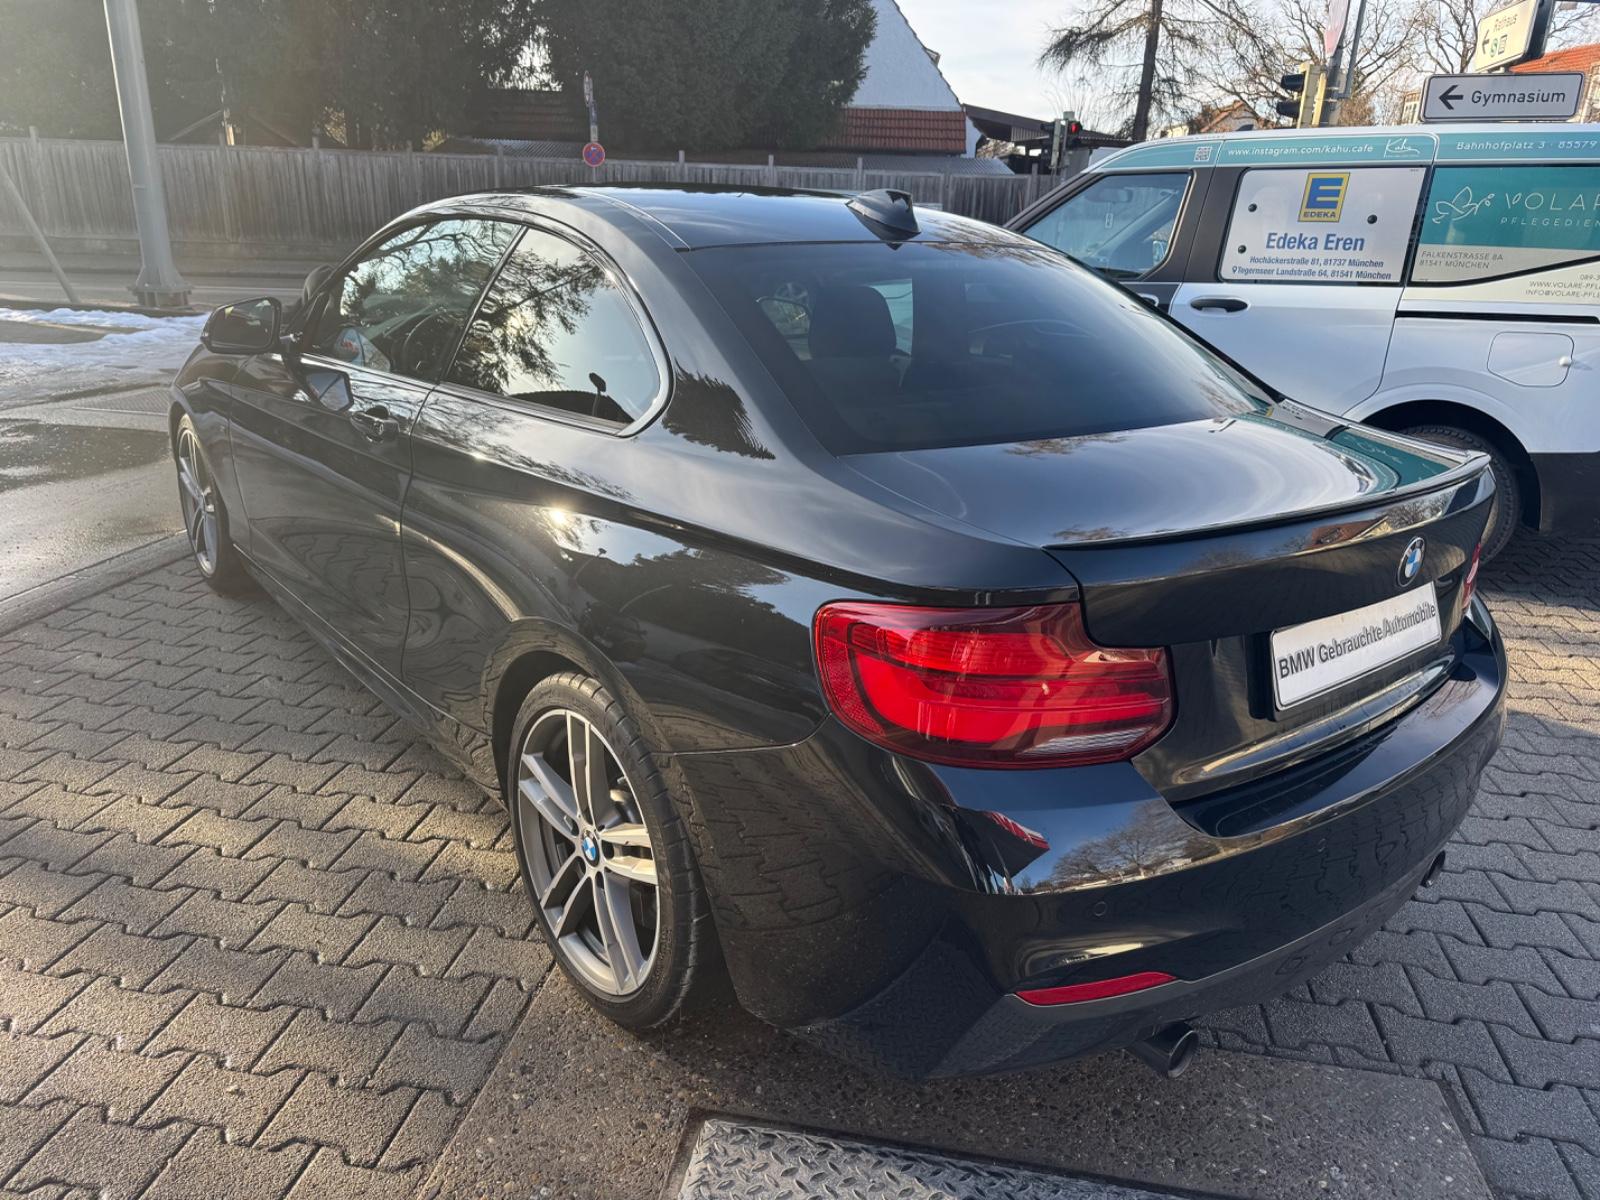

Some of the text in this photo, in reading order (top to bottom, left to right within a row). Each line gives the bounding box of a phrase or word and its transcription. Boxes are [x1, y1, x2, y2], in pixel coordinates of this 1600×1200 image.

[1471, 90, 1566, 107] Gymnasium
[1228, 144, 1374, 156] www.instagram.com/kahu.cafe
[1456, 140, 1597, 151] Bahnhofplatz 3 85579
[1266, 232, 1365, 251] Edeka Eren
[1421, 250, 1490, 260] FALKENSTRASSE
[1250, 256, 1384, 268] Hochäckerstraße 81, 81737 München
[1445, 260, 1490, 269] MÜNCHEN
[1238, 266, 1275, 275] Tegernseer
[1276, 268, 1316, 277] Landstraße
[1330, 270, 1353, 278] 81541
[1355, 271, 1391, 280] München
[1529, 280, 1600, 290] WWW.VOLARE-PFL
[1278, 602, 1436, 679] BMW Gebrauchte Automobile
